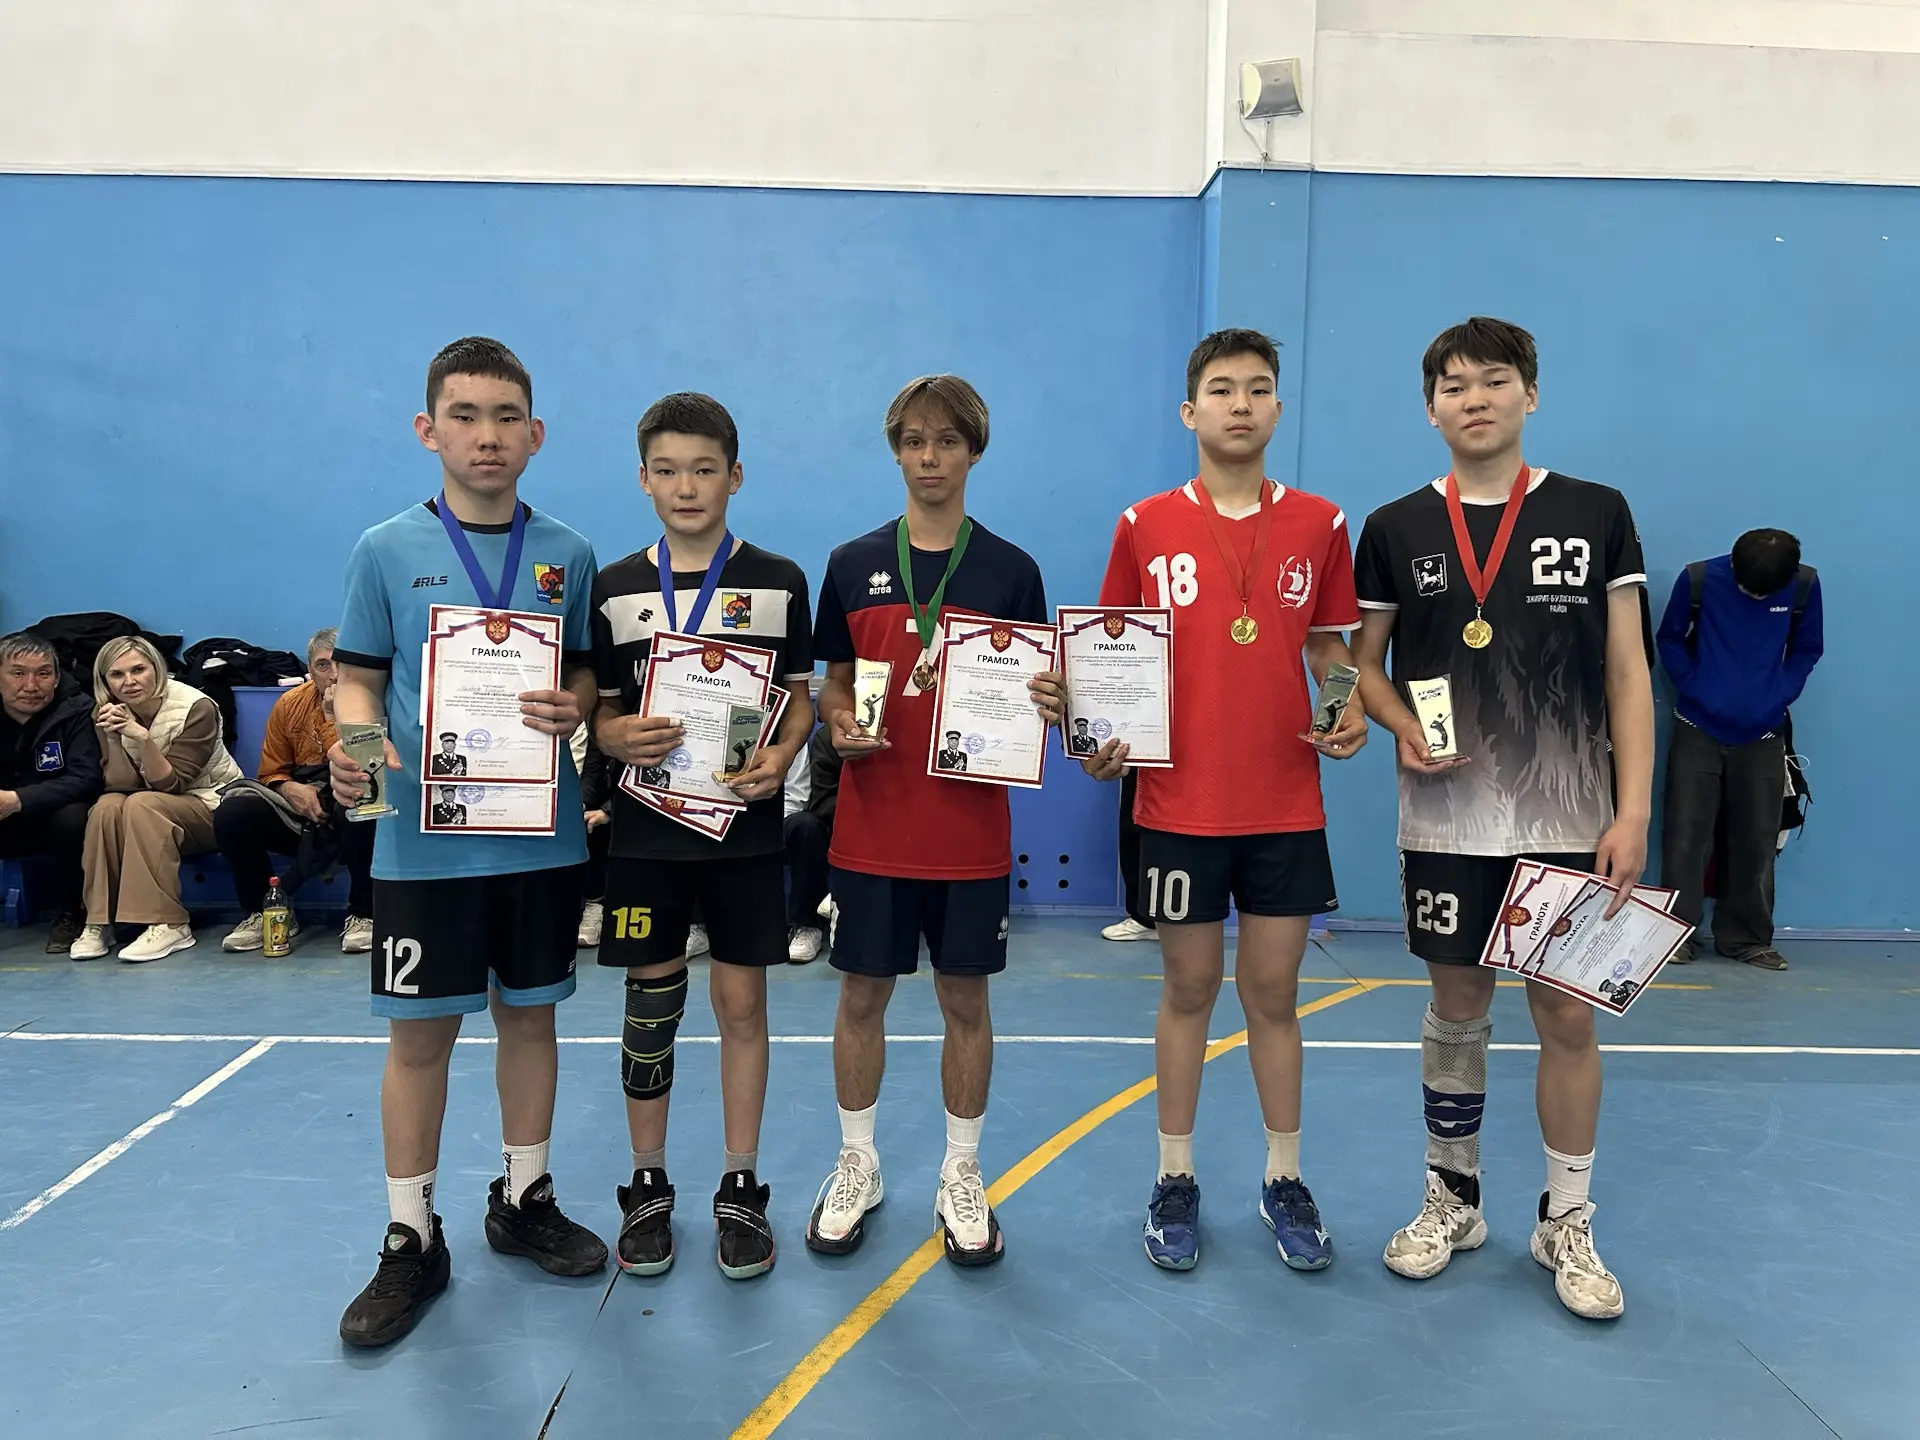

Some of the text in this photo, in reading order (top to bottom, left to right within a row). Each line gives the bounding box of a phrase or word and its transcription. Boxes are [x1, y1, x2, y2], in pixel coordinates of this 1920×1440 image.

[1147, 552, 1199, 608] 18
[1530, 537, 1591, 587] 23
[471, 647, 522, 659] ГРАМОТА
[977, 654, 1020, 667] ГРАМОТА
[1093, 643, 1137, 652] ГРАМОТА
[686, 673, 732, 689] ГРАМОТА
[1147, 867, 1191, 921] 10
[1415, 888, 1459, 935] 23
[612, 906, 652, 939] 15
[1529, 901, 1551, 941] ГРАМОТА
[1559, 914, 1589, 952] ГРАМОТА
[382, 936, 423, 994] 12
